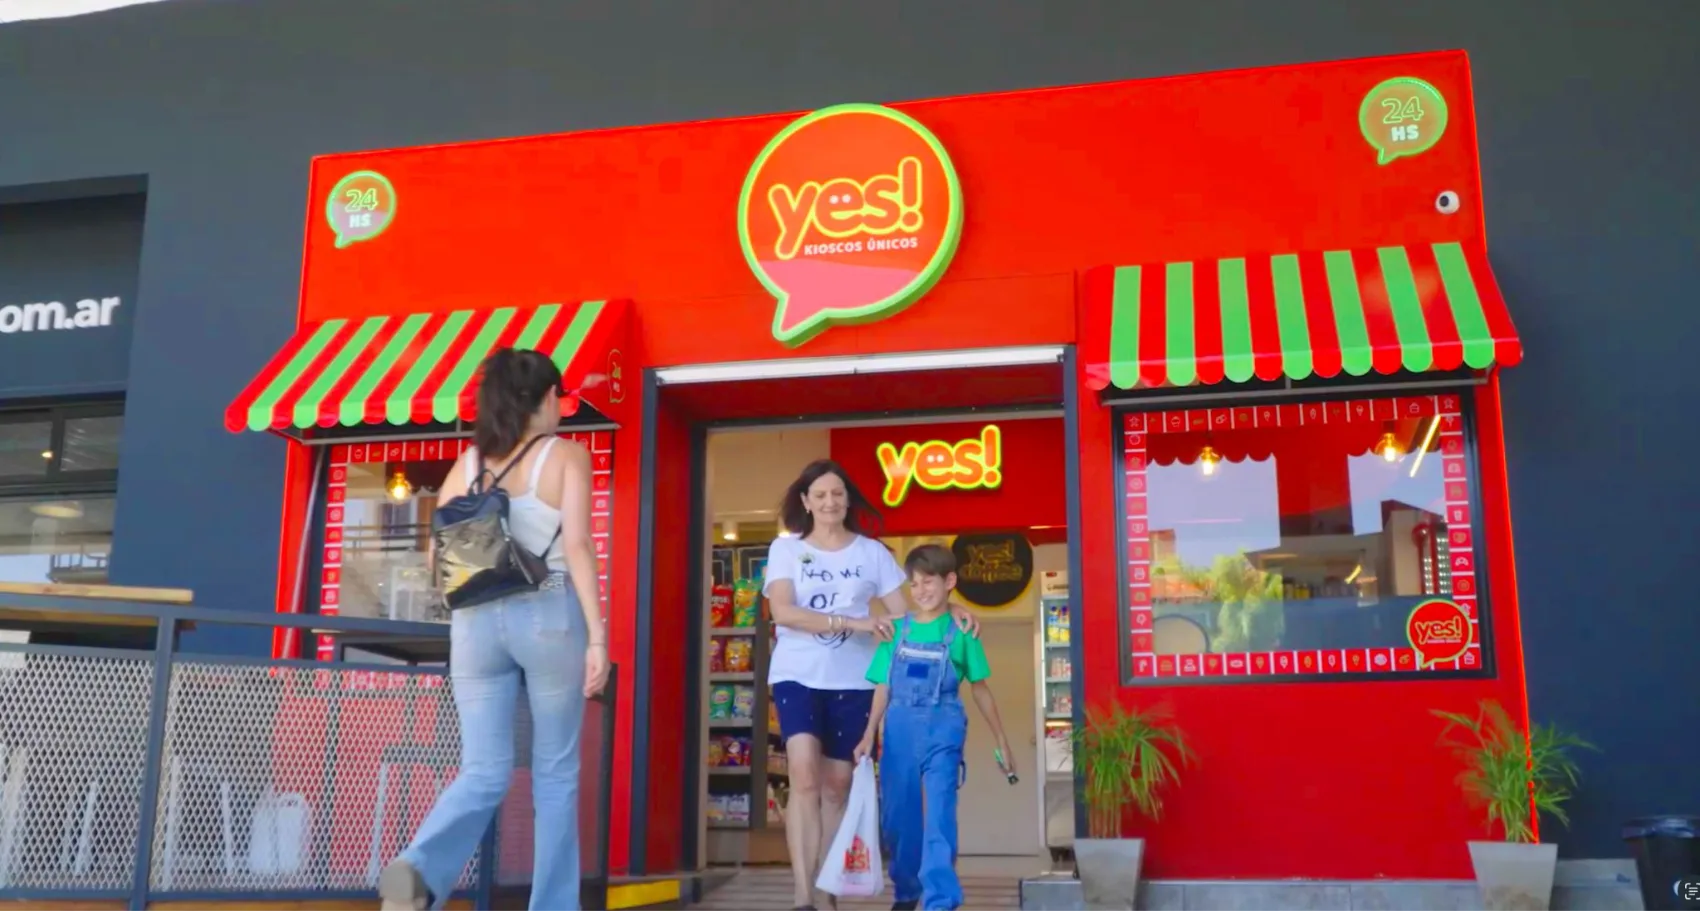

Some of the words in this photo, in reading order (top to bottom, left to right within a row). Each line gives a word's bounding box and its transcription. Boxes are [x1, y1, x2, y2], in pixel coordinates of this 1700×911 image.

[1381, 96, 1424, 124] 24
[1391, 124, 1420, 142] HS
[345, 187, 378, 212] 24
[768, 156, 923, 260] yes!
[349, 213, 372, 228] HS
[804, 241, 862, 256] KIOSCOS
[876, 424, 1002, 507] yes!
[1414, 615, 1463, 645] yes!
